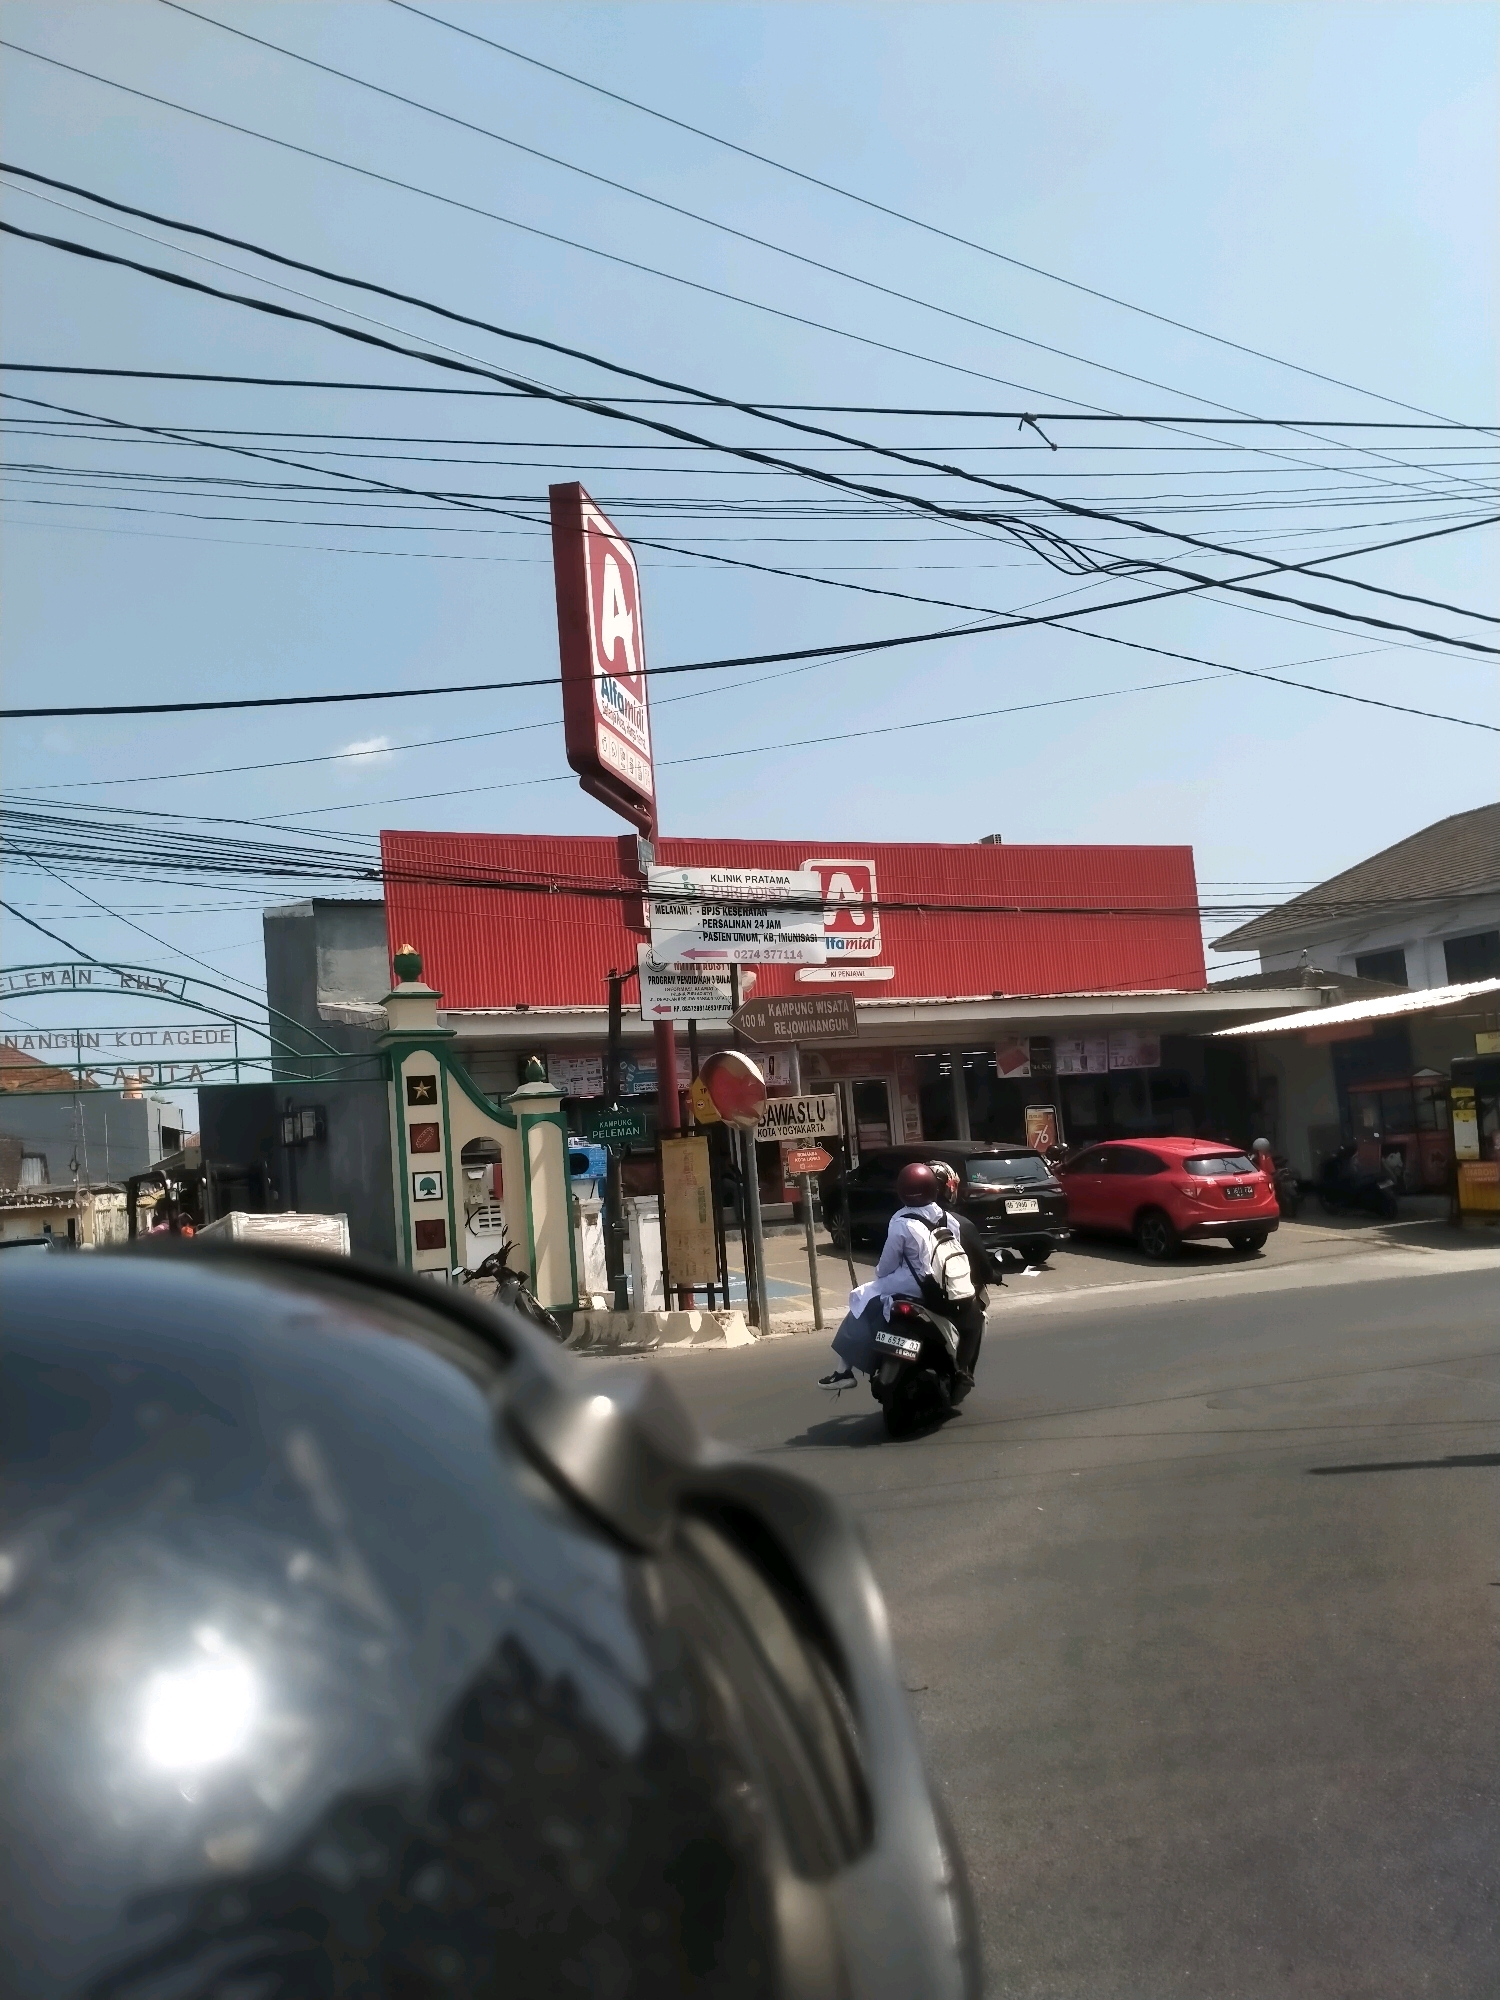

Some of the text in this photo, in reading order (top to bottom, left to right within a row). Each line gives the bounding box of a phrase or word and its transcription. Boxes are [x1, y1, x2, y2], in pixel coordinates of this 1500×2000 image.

[601, 671, 644, 734] Alfamidi
[711, 874, 790, 885] KLINIK PRATAMA
[702, 907, 768, 917] BPJS KESEHATAN
[702, 919, 782, 930] PERSALINAN 24 JAM
[703, 932, 731, 942] PASIEN
[778, 933, 818, 943] IMUNISASI
[825, 937, 875, 950] lfamidi
[734, 950, 803, 960] 0274 377114
[648, 976, 675, 985] PROGRAM
[677, 976, 710, 985] PENDIDIKAN
[716, 975, 731, 984] BULA
[768, 1000, 849, 1017] KAMPUNG WISATA
[740, 1013, 766, 1027] 100 M
[774, 1018, 849, 1035] REJOWINANGUN
[115, 1029, 231, 1048] KOTAGEDE
[593, 1119, 640, 1138] KAMPUNG PELEMAN
[758, 1123, 826, 1137] KOTA YOGYAKARTA
[1034, 1124, 1049, 1149] 76
